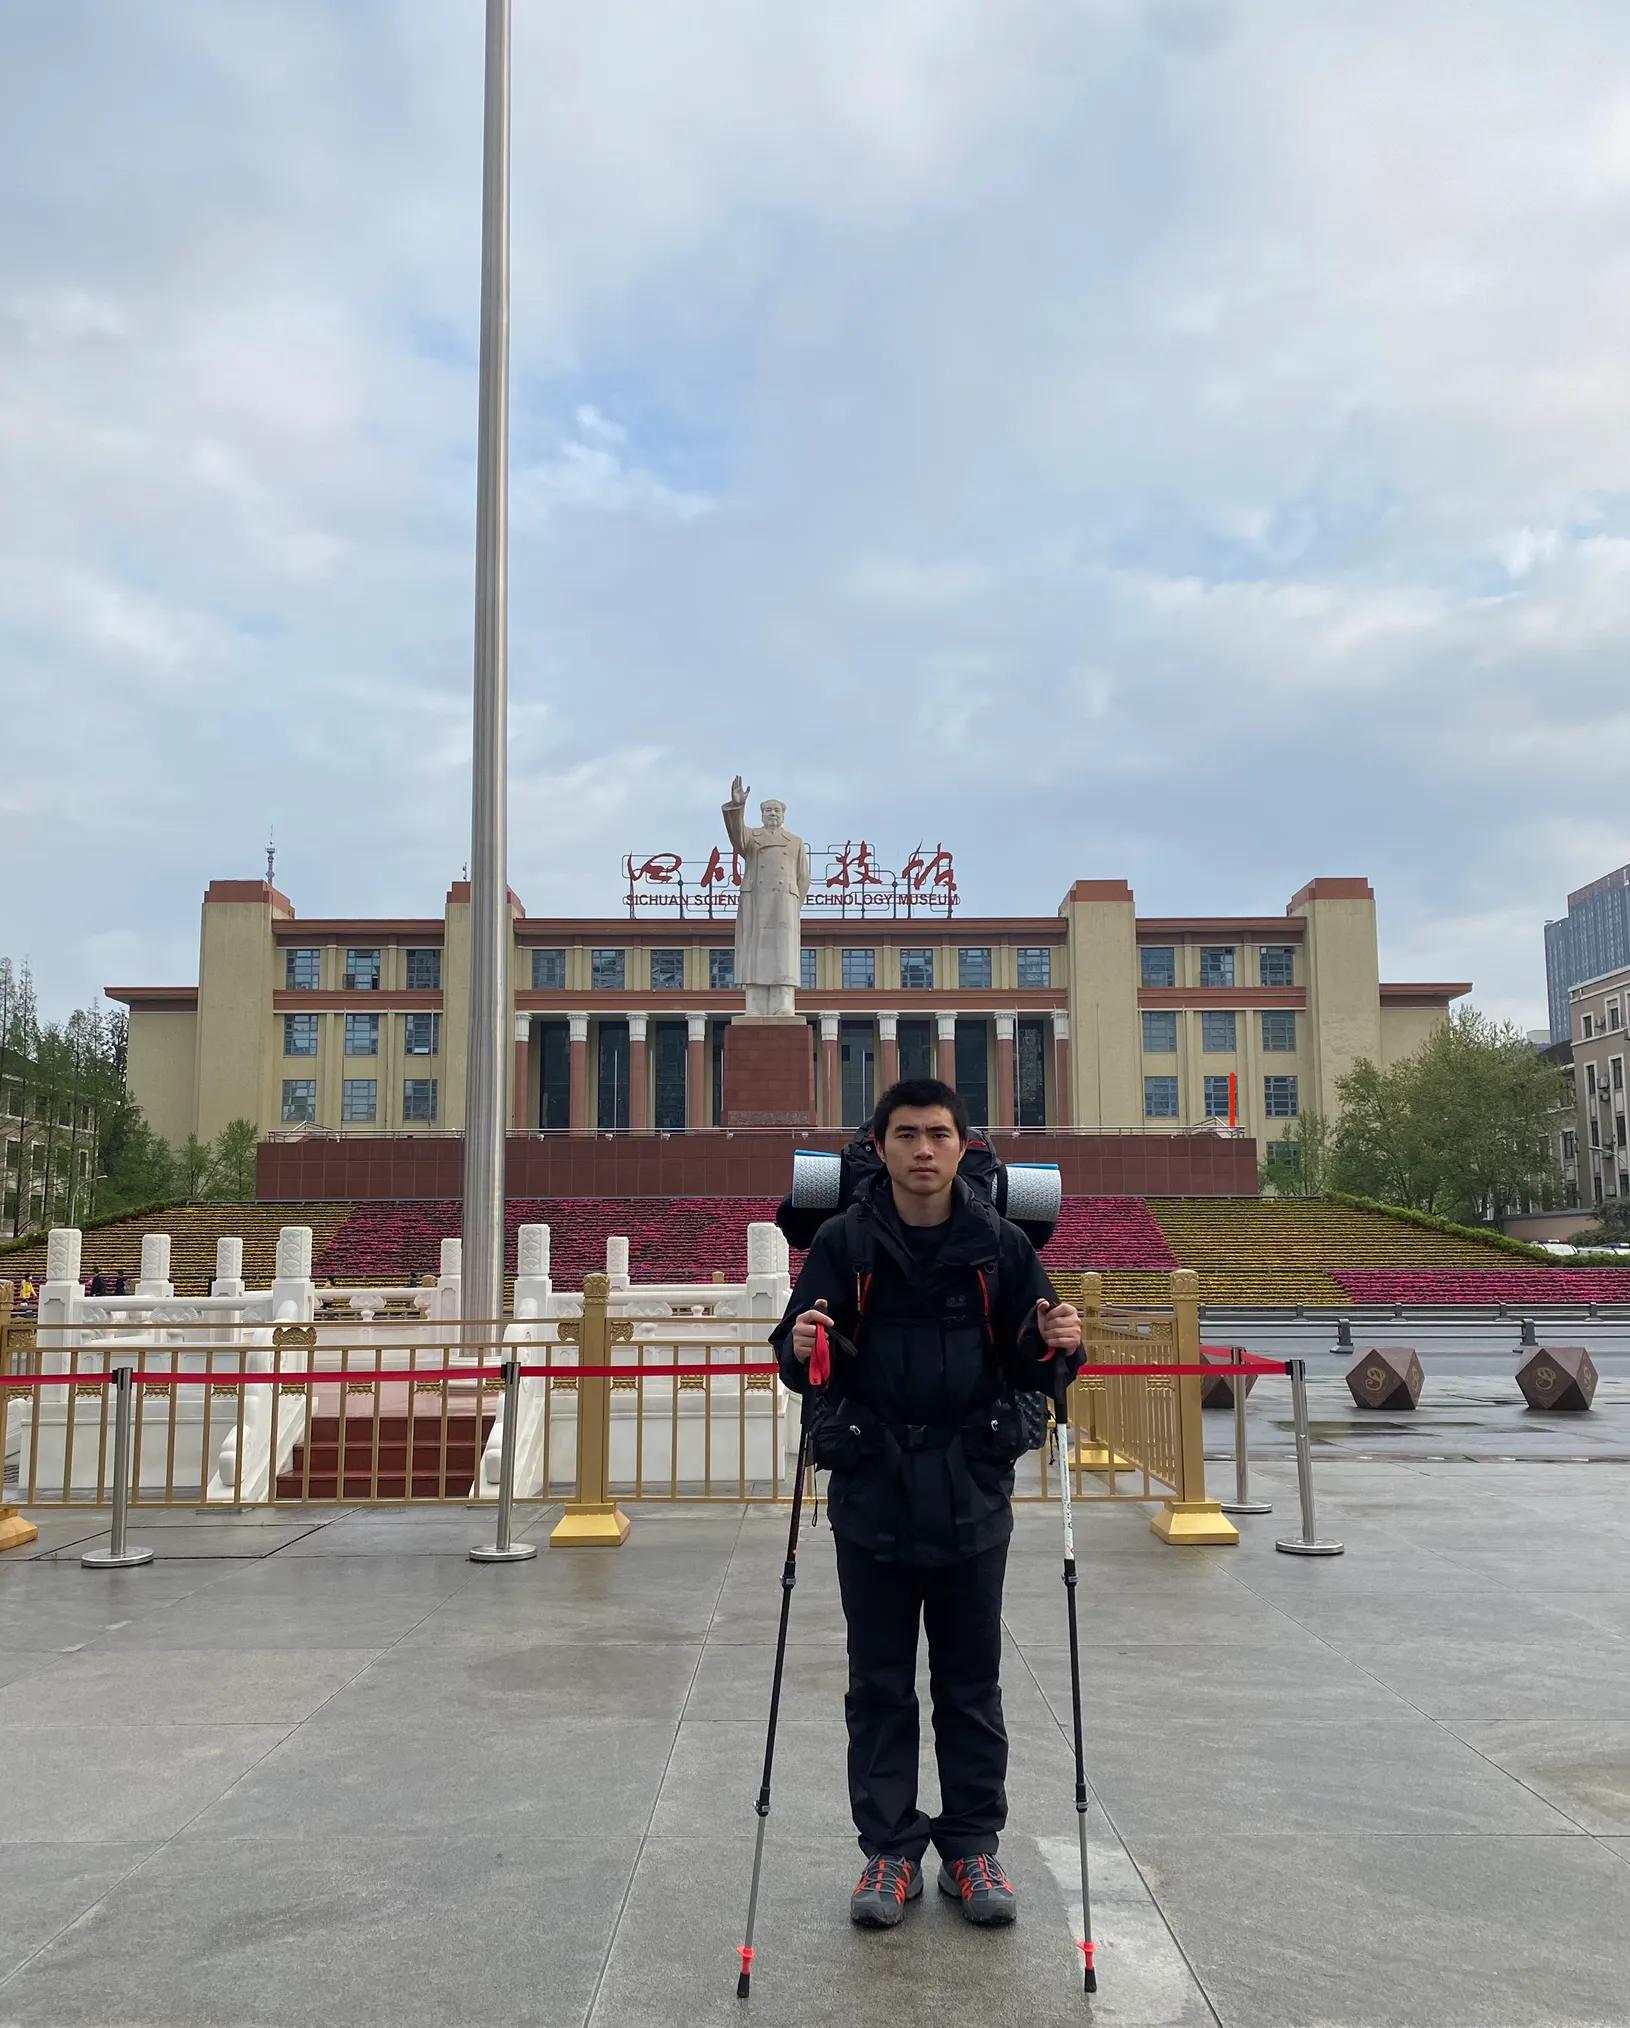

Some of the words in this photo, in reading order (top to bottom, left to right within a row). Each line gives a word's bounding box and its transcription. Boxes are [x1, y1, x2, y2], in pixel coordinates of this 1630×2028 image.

[627, 839, 957, 891] 四川技馆
[625, 894, 689, 906] SICHUAN
[694, 894, 740, 906] SCIEN
[804, 893, 891, 906] ECHNOLOGY
[899, 893, 961, 906] MUSEUM
